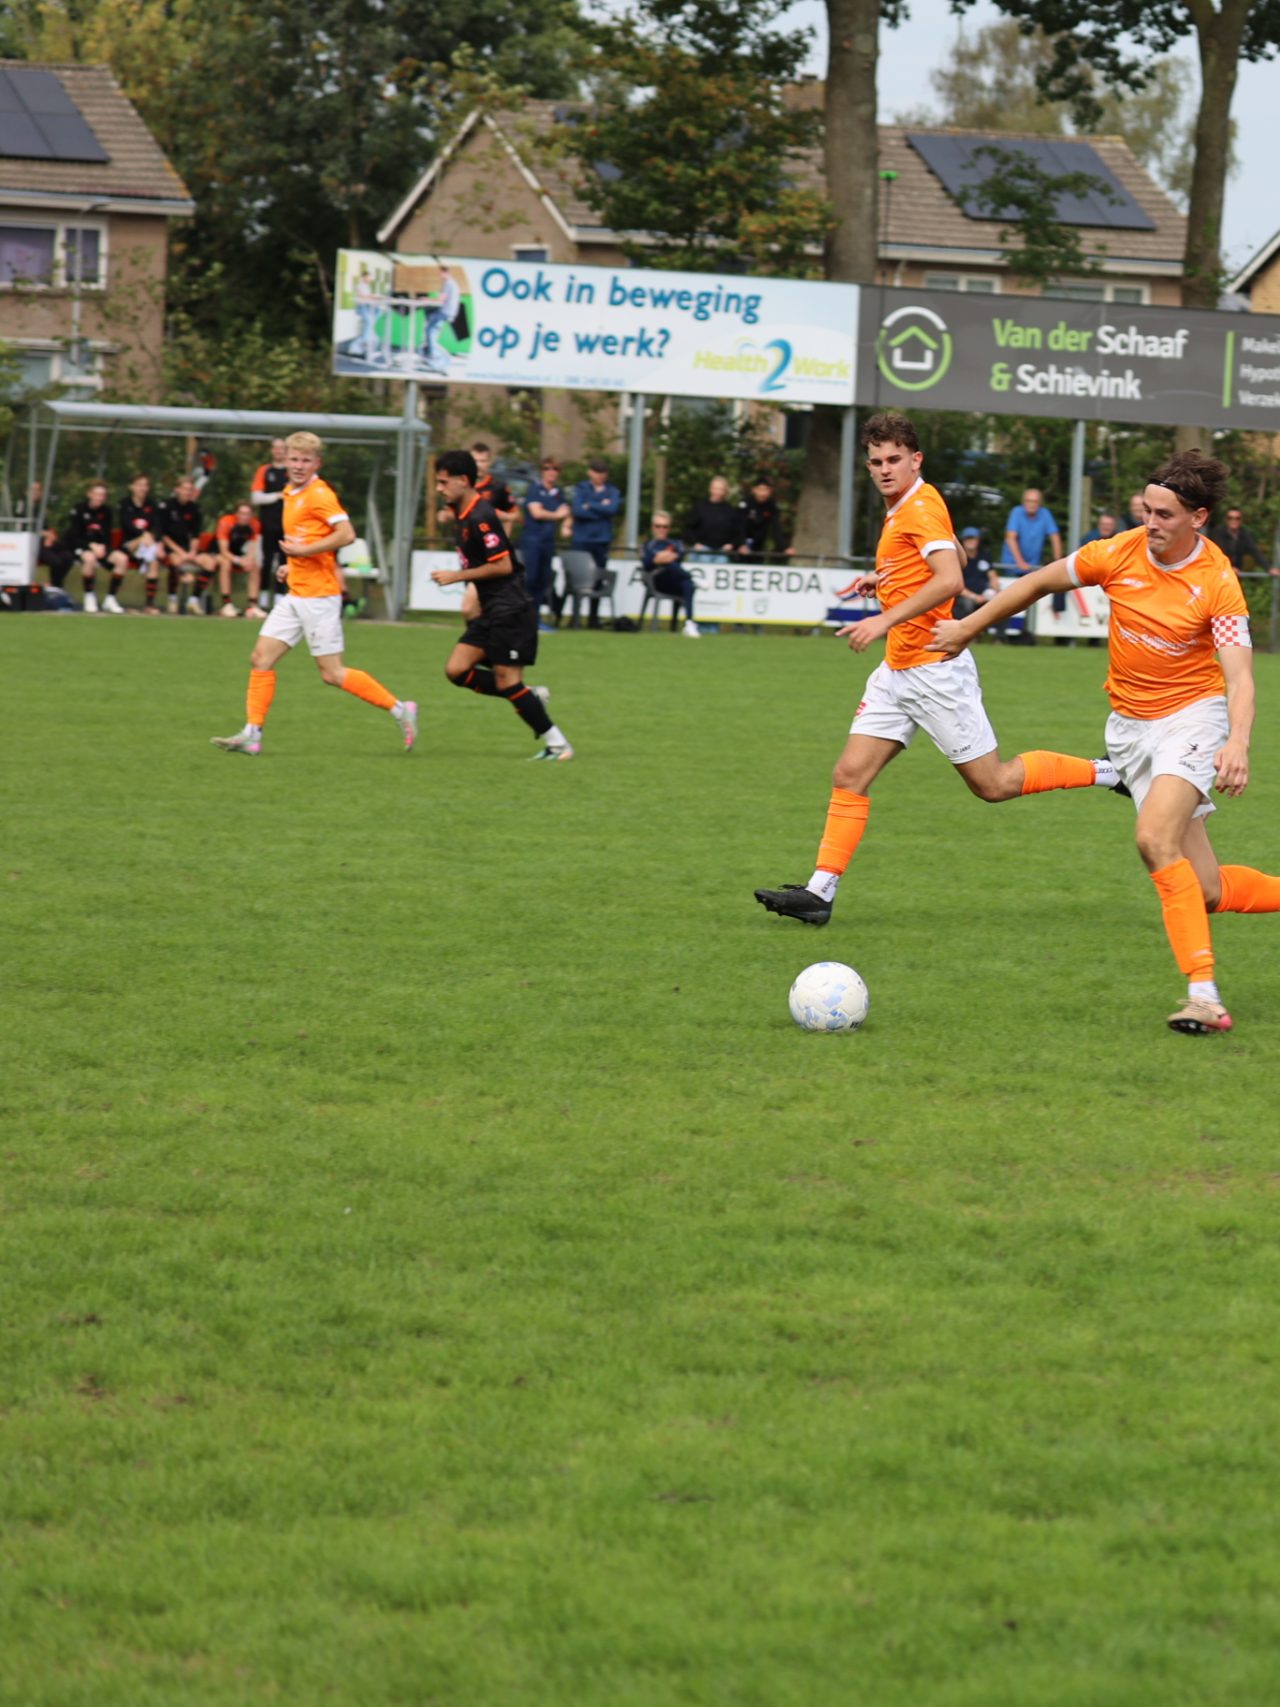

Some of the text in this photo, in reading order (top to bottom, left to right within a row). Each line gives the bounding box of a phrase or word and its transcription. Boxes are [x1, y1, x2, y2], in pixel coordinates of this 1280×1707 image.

[481, 267, 762, 324] Ook in beweging
[478, 322, 671, 360] op je werk?
[992, 318, 1190, 359] Van der Schaaf
[990, 362, 1142, 399] & Schievink
[714, 569, 823, 593] BEERDA
